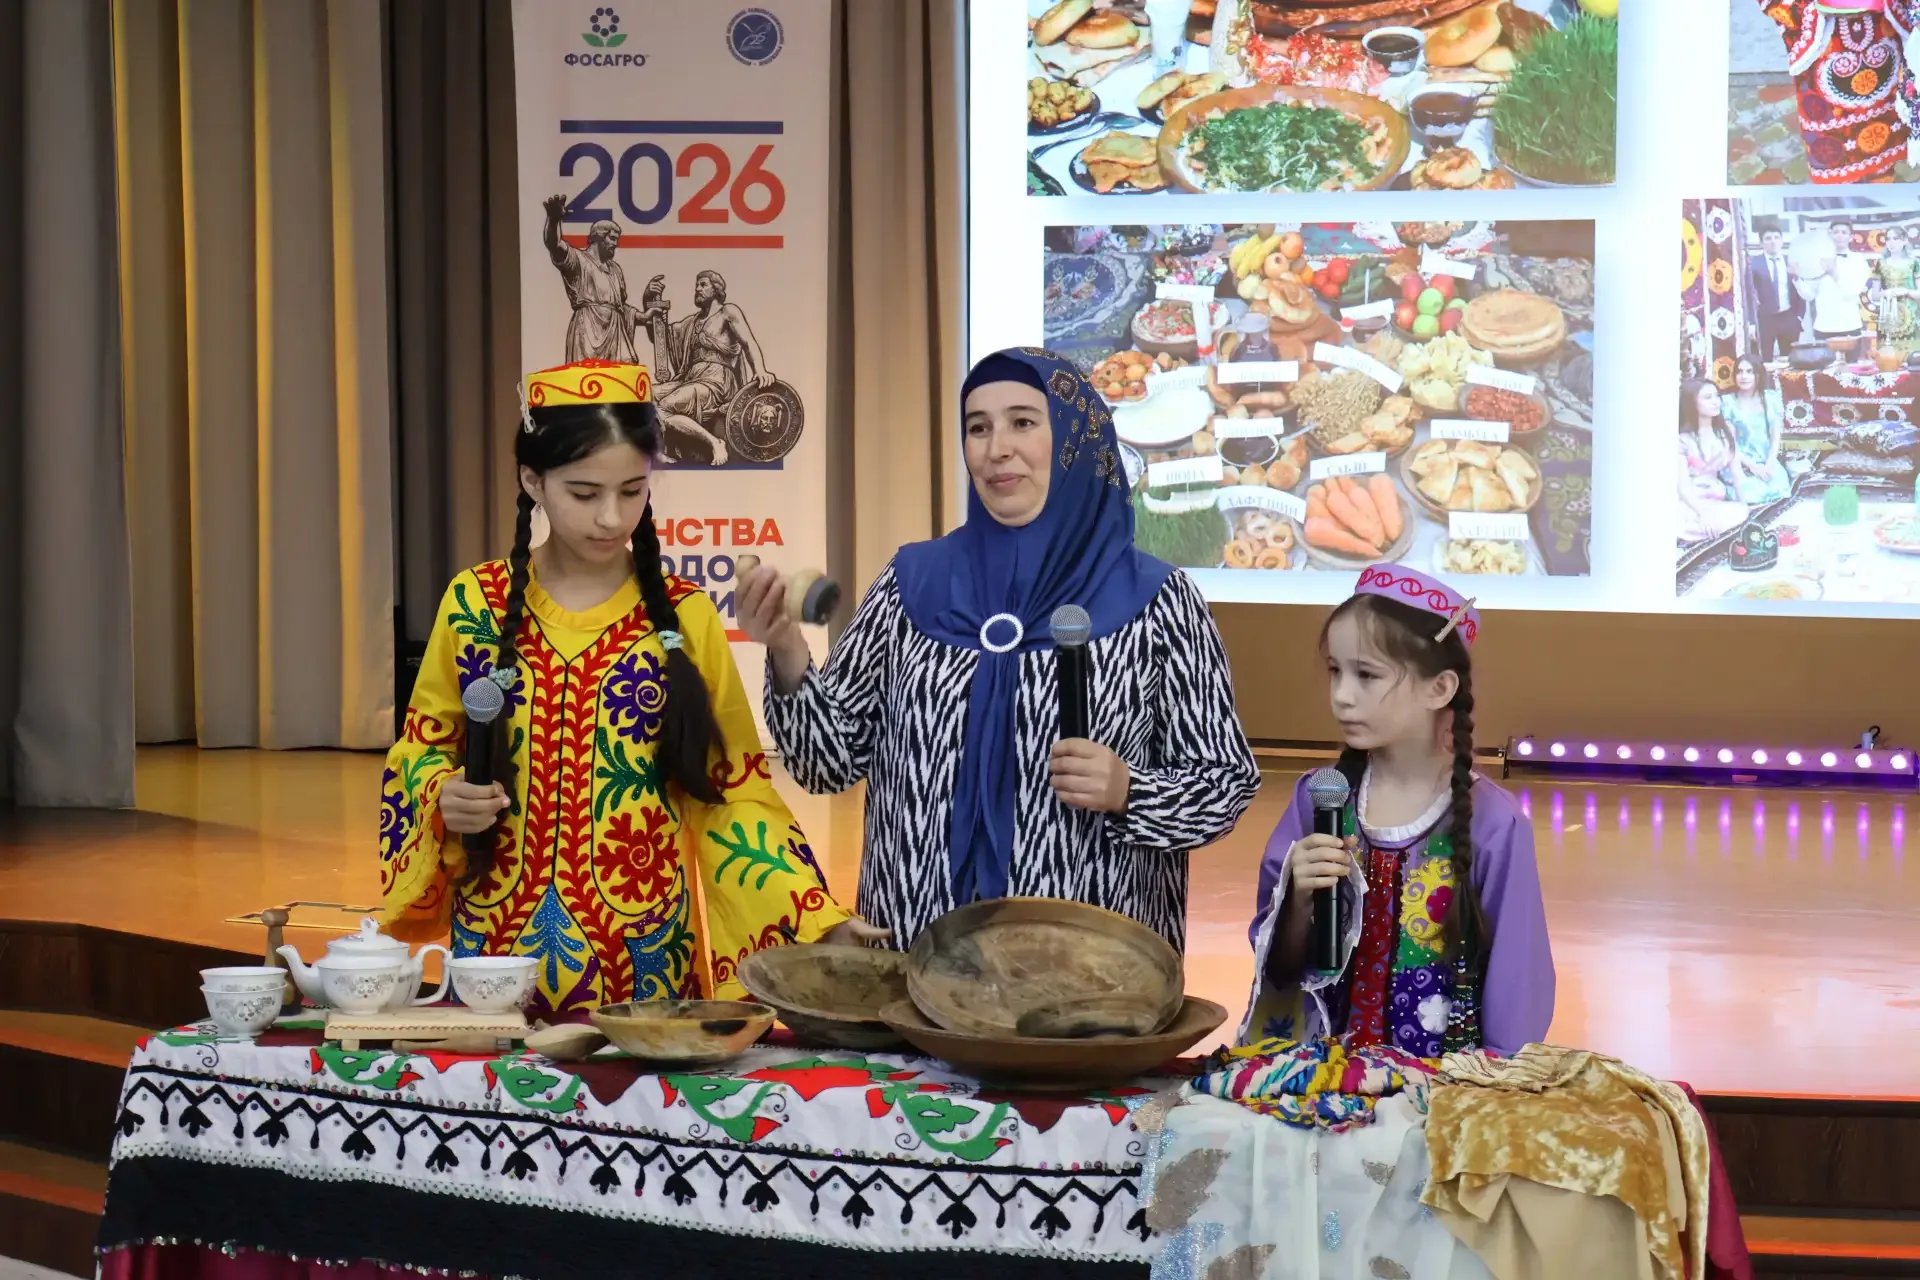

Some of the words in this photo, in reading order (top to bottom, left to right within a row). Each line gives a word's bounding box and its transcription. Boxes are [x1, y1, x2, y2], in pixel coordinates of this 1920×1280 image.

[564, 53, 646, 67] ФОСАГРО
[559, 142, 786, 225] 2026
[652, 518, 784, 546] НСТВА
